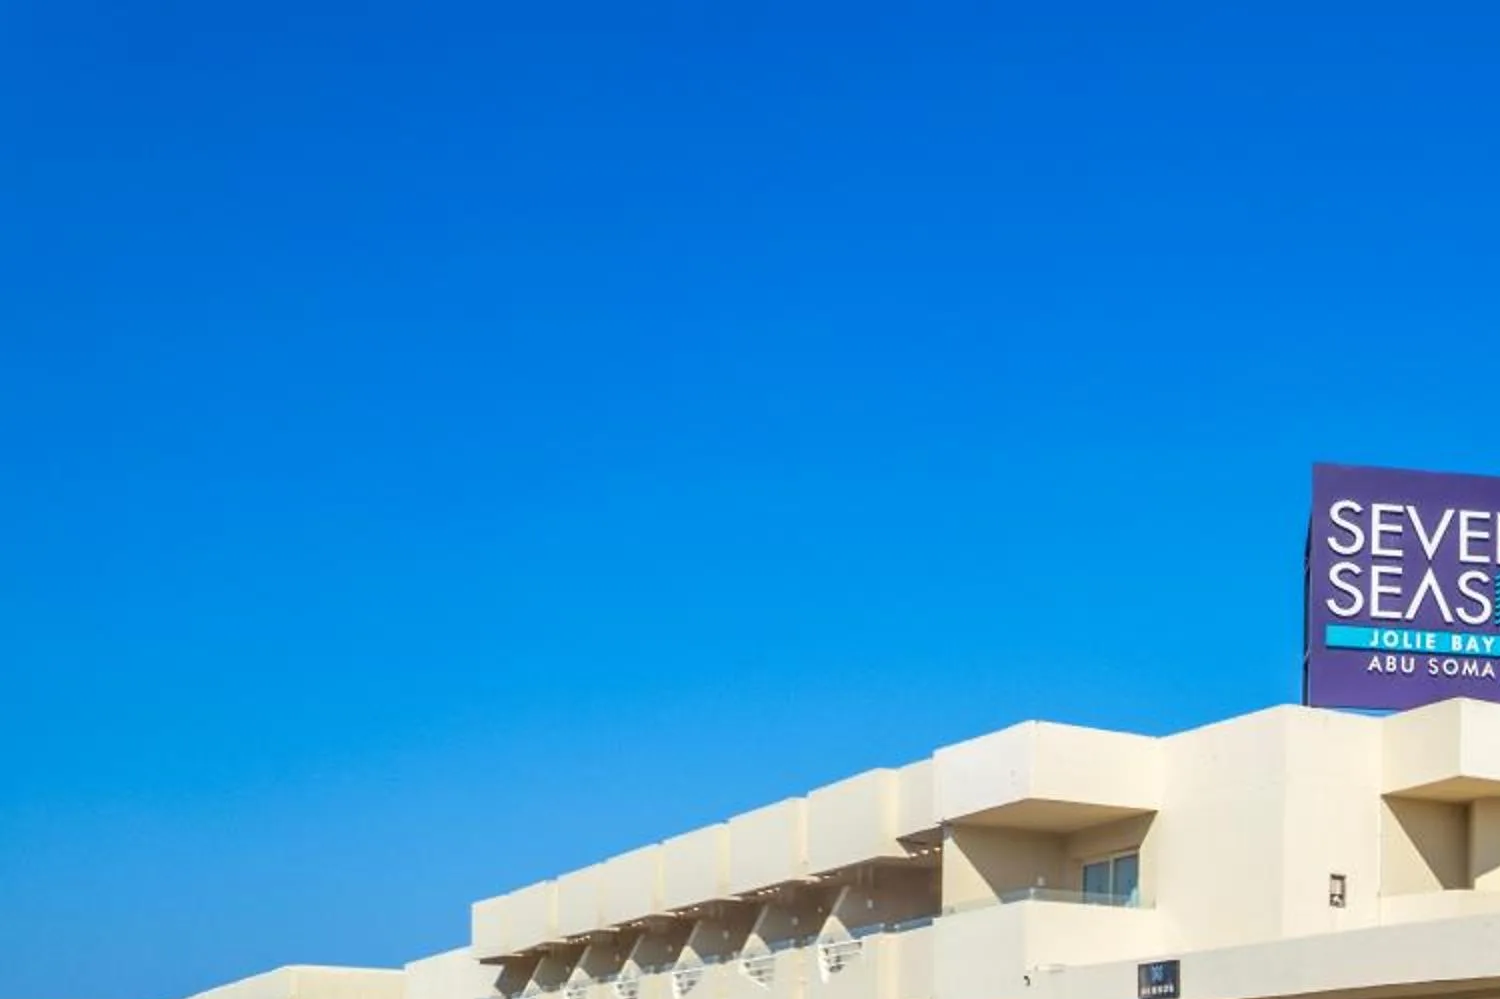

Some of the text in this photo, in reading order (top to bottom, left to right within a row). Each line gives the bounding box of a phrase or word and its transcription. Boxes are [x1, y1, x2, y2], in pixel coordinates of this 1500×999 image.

[1325, 561, 1493, 625] SEAS
[1369, 628, 1496, 653] JOLIE BAY
[1367, 655, 1496, 678] ABU SOMA
